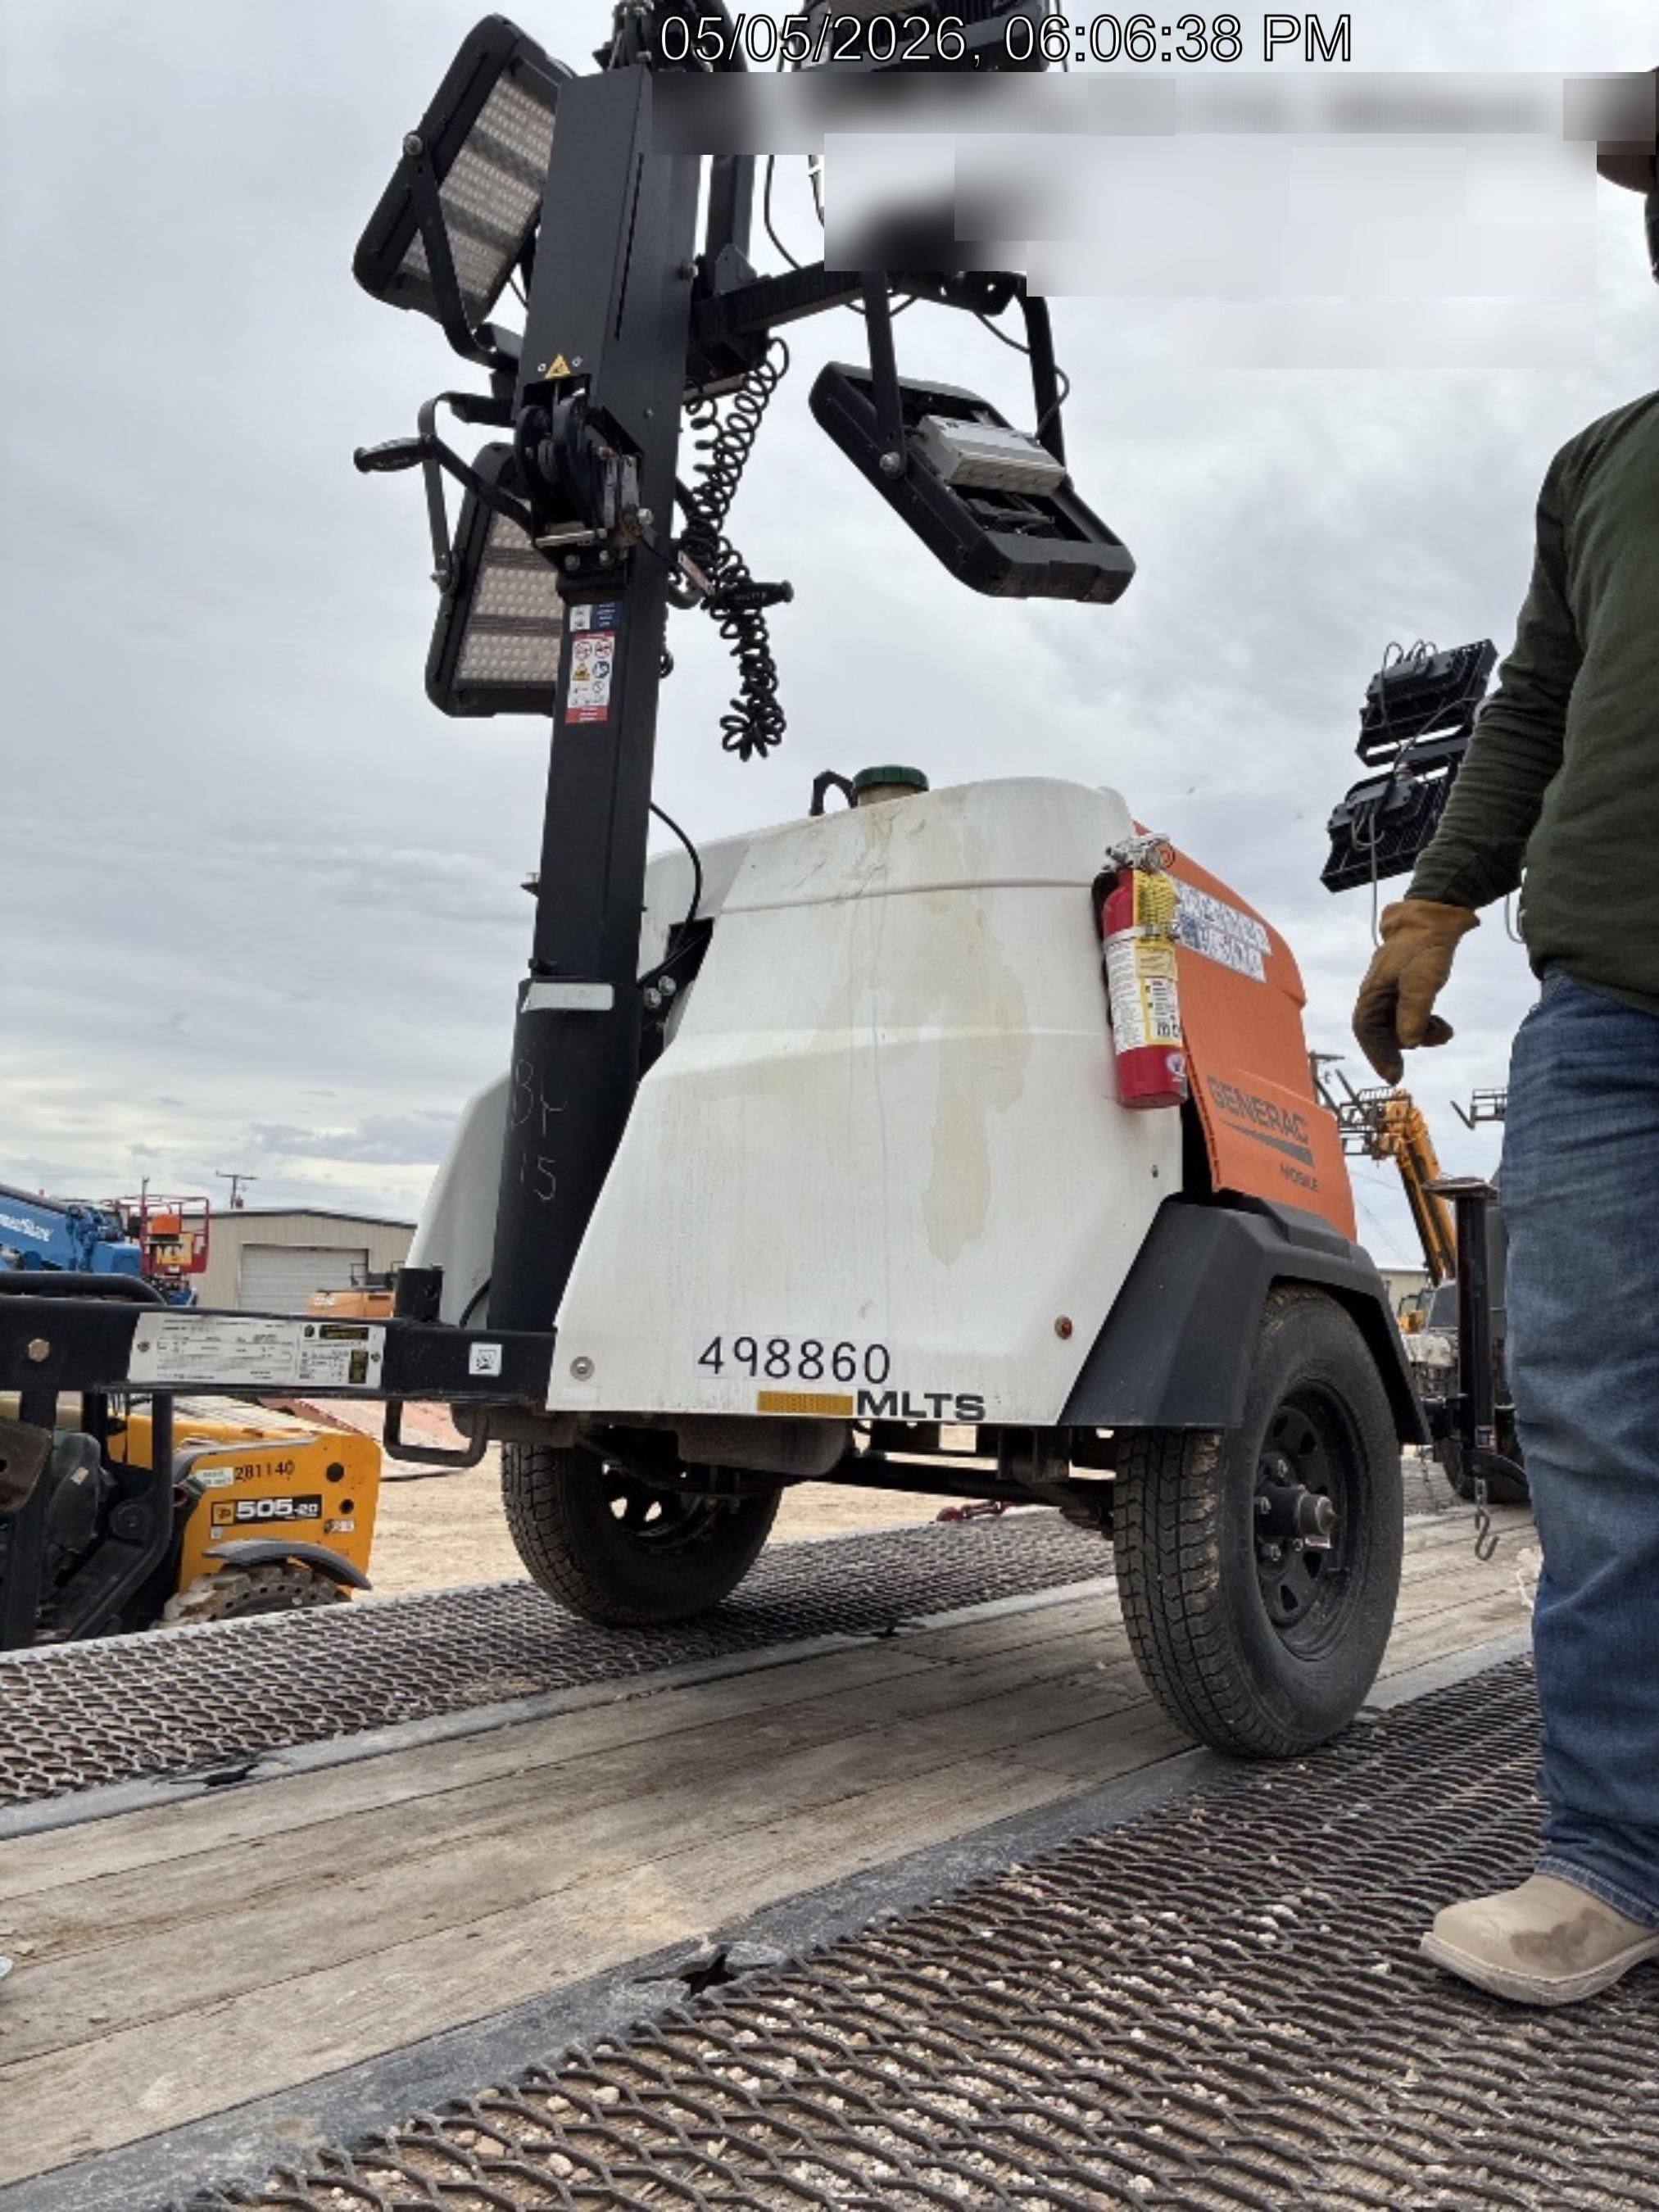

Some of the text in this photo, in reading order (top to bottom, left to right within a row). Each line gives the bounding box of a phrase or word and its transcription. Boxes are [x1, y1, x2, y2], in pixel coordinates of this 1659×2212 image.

[1206, 1074, 1309, 1145] GENERAC
[697, 1335, 891, 1385] 498860
[856, 1390, 986, 1421] MLTS
[234, 1459, 295, 1481] 281140
